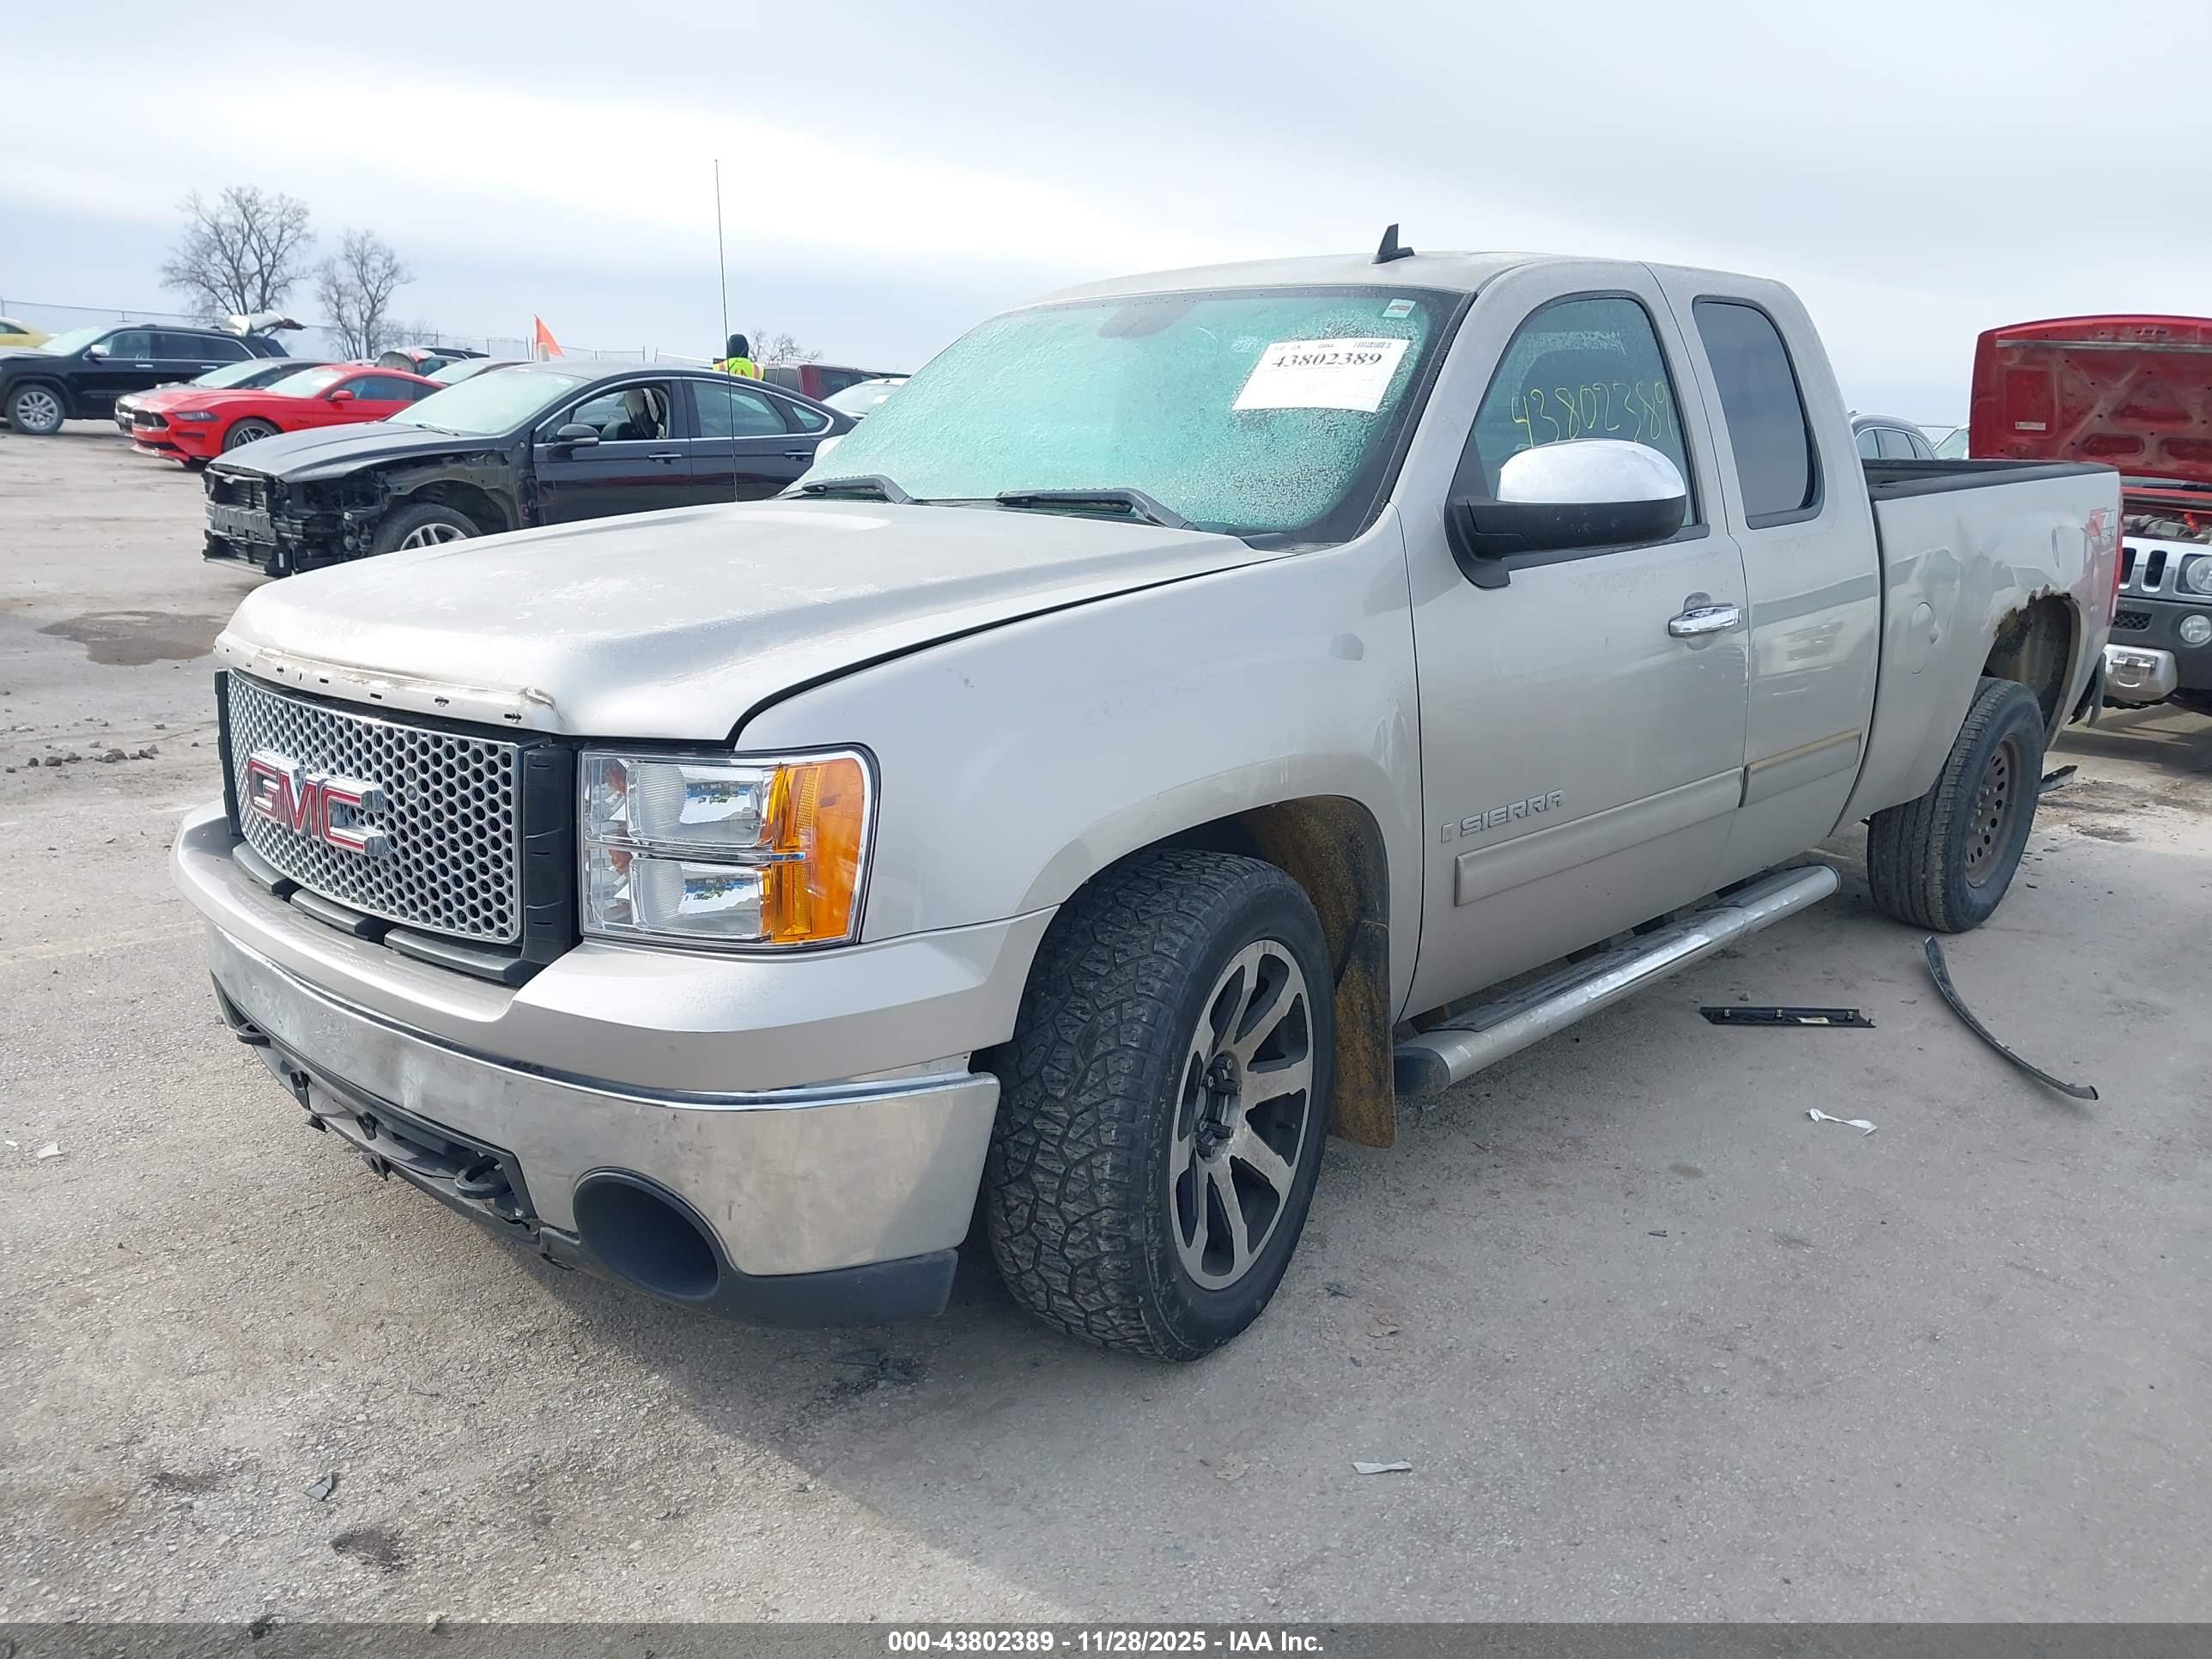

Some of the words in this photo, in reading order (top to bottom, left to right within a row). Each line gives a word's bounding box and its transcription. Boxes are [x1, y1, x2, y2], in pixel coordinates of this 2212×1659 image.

[1272, 352, 1382, 368] 43802389
[1511, 380, 1674, 449] 43802389
[247, 755, 380, 855] GMC
[1460, 789, 1565, 837] SIERRA
